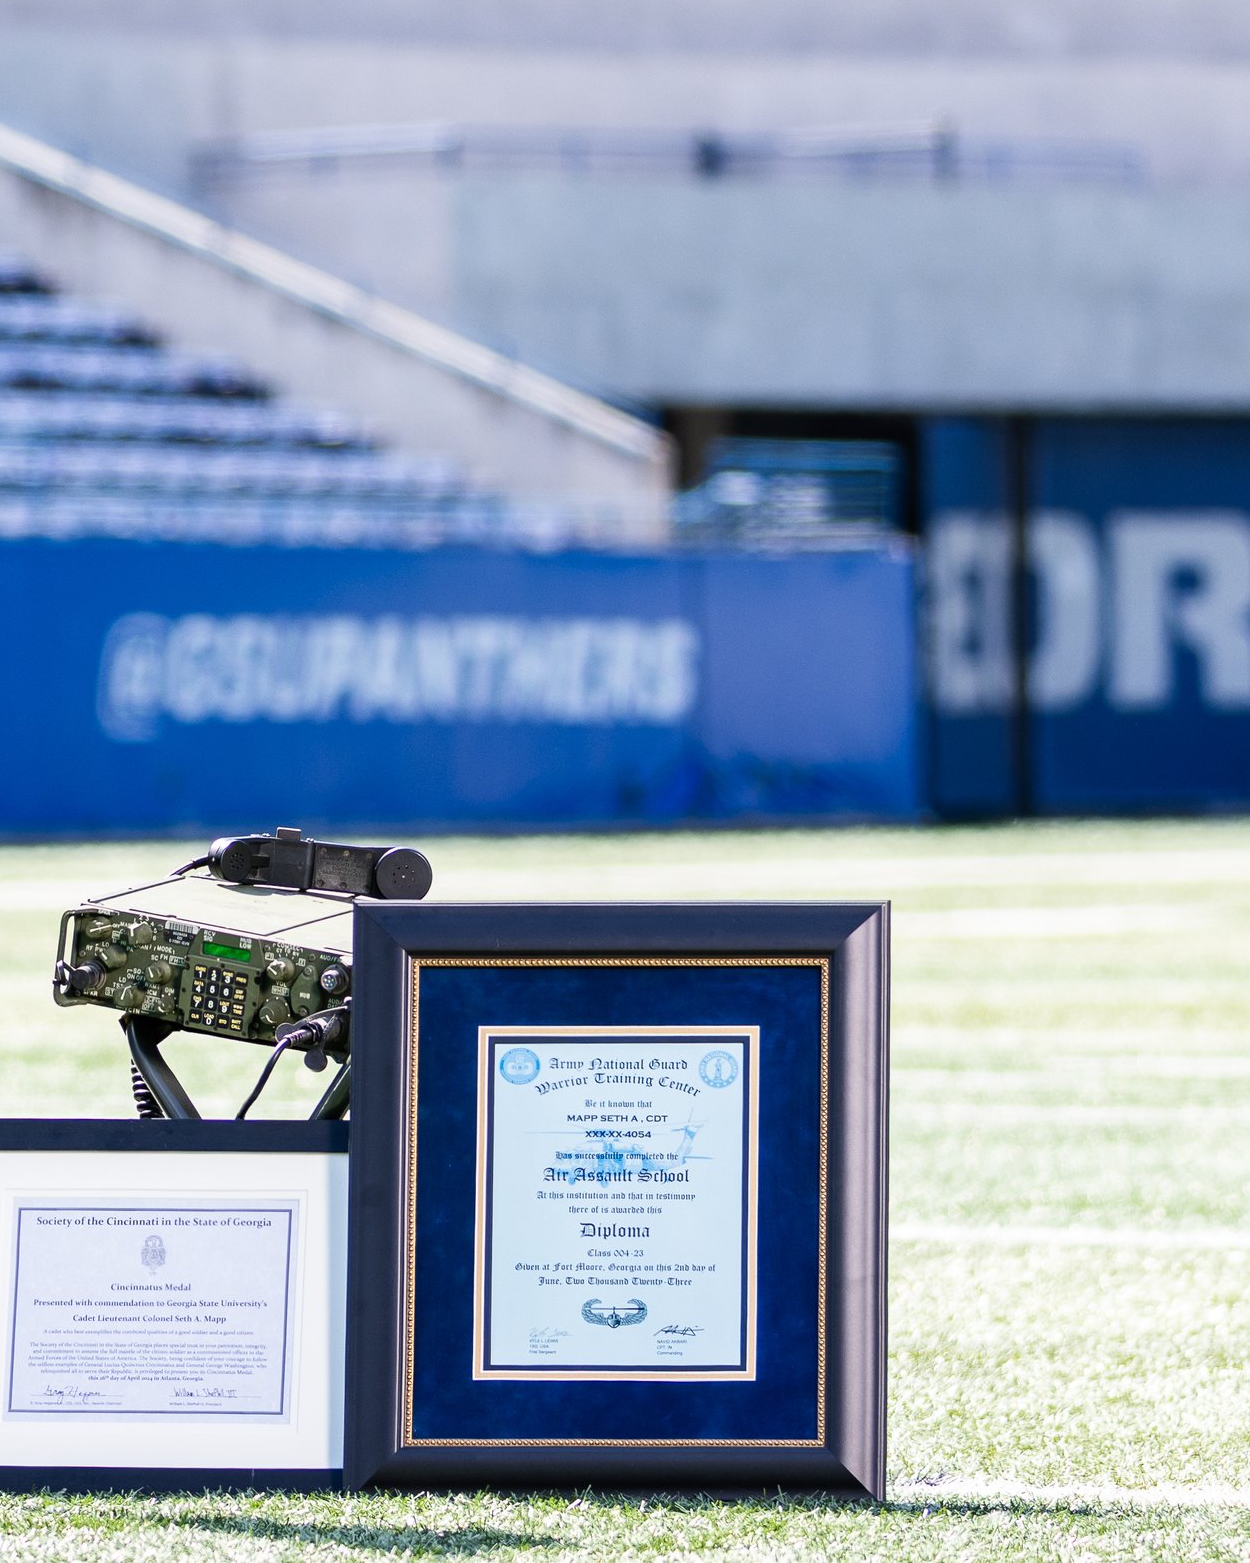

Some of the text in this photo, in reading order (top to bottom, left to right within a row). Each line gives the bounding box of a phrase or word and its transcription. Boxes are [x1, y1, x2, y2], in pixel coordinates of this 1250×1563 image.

[225, 976, 231, 984] 3
[223, 988, 230, 996] 6
[208, 1001, 214, 1009] 8
[549, 1058, 688, 1071] Army National Guard
[535, 1073, 702, 1098] Warrior Training Center
[585, 1099, 652, 1109] Be it known that
[600, 1115, 629, 1123] SETH
[585, 1130, 652, 1138] XXX-XX-4054
[555, 1152, 679, 1161] Has successfully completed the
[543, 1168, 690, 1184] Air Assault School
[536, 1191, 696, 1201] At this institution and that in testimony
[568, 1206, 662, 1214] there of is awarded this
[37, 1217, 272, 1228] Society of the Cincinnati in the State of Georgia
[580, 1223, 650, 1239] Diploma
[587, 1249, 611, 1257] Class
[515, 1263, 540, 1272] Given
[542, 1263, 550, 1272] at
[552, 1263, 573, 1272] Fort
[608, 1264, 642, 1272] Georgia
[644, 1264, 654, 1272] on
[656, 1264, 672, 1272] this
[674, 1264, 690, 1272] 2nd
[692, 1264, 706, 1272] day
[708, 1264, 716, 1272] of
[565, 1277, 585, 1286] Two
[588, 1277, 629, 1286] Thousand
[632, 1278, 693, 1286] Twenty-Three
[111, 1283, 191, 1291] Cincinnatus Medal
[34, 1299, 73, 1307] Presented
[75, 1299, 93, 1307] with
[95, 1299, 155, 1307] commendation
[167, 1300, 197, 1308] Georgia
[199, 1300, 219, 1308] State
[221, 1300, 268, 1308] University's
[98, 1315, 141, 1323] Lieutenant
[143, 1315, 173, 1323] Colonel
[175, 1315, 192, 1323] Seth
[195, 1315, 202, 1323] A.
[204, 1315, 227, 1323] Mapp
